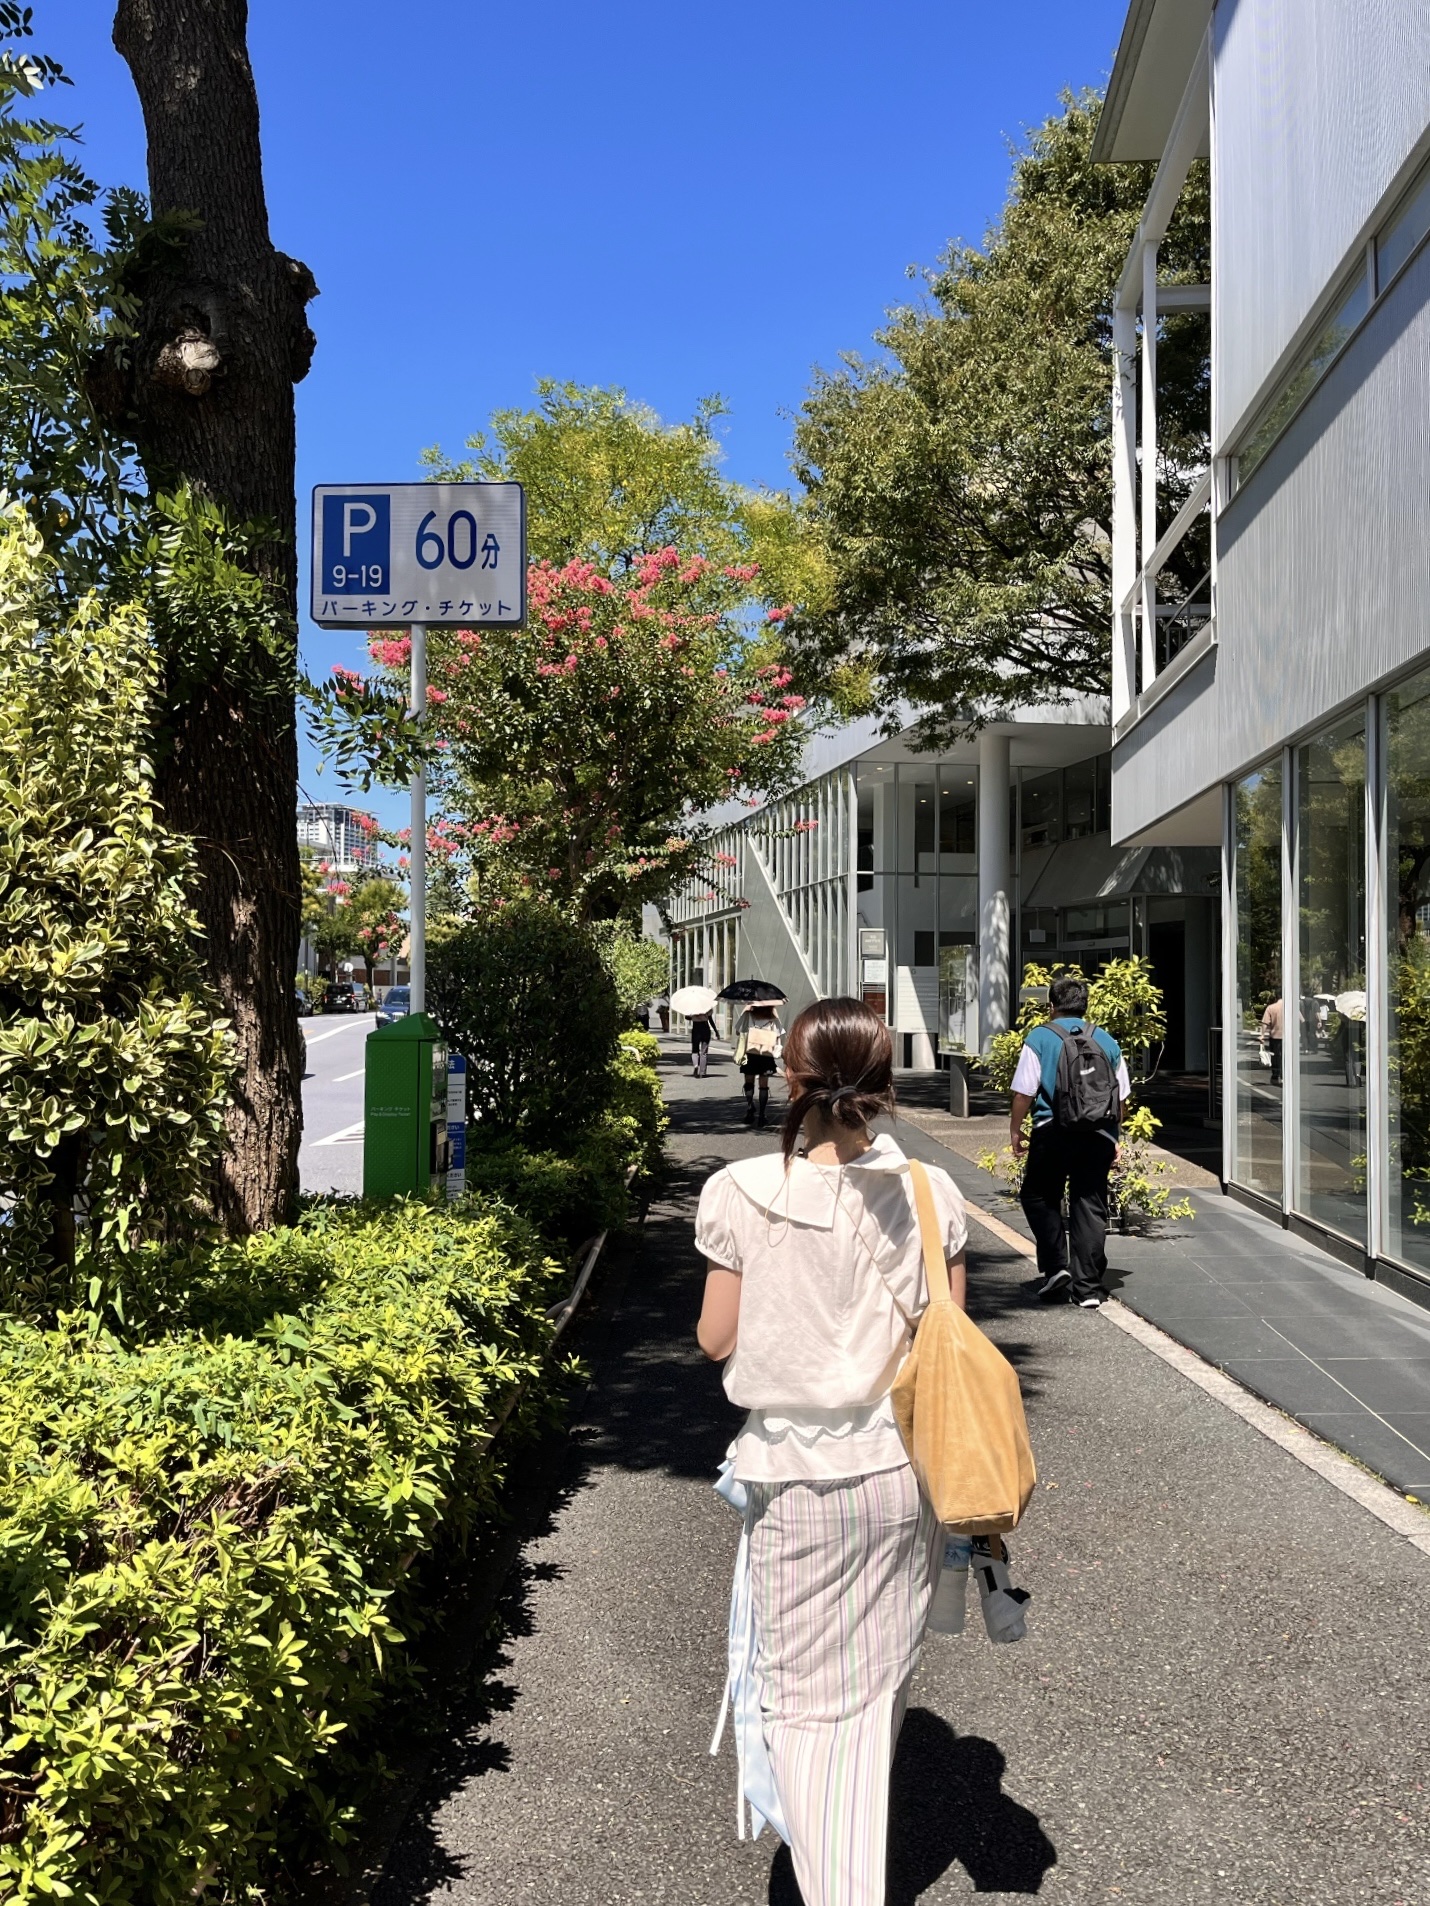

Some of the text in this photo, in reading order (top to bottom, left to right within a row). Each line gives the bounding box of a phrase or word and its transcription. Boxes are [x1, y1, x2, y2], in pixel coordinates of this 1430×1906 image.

[343, 502, 377, 557] P
[415, 509, 501, 570] 60分
[332, 564, 383, 588] 9-19
[321, 600, 512, 617] パーキング・チケット
